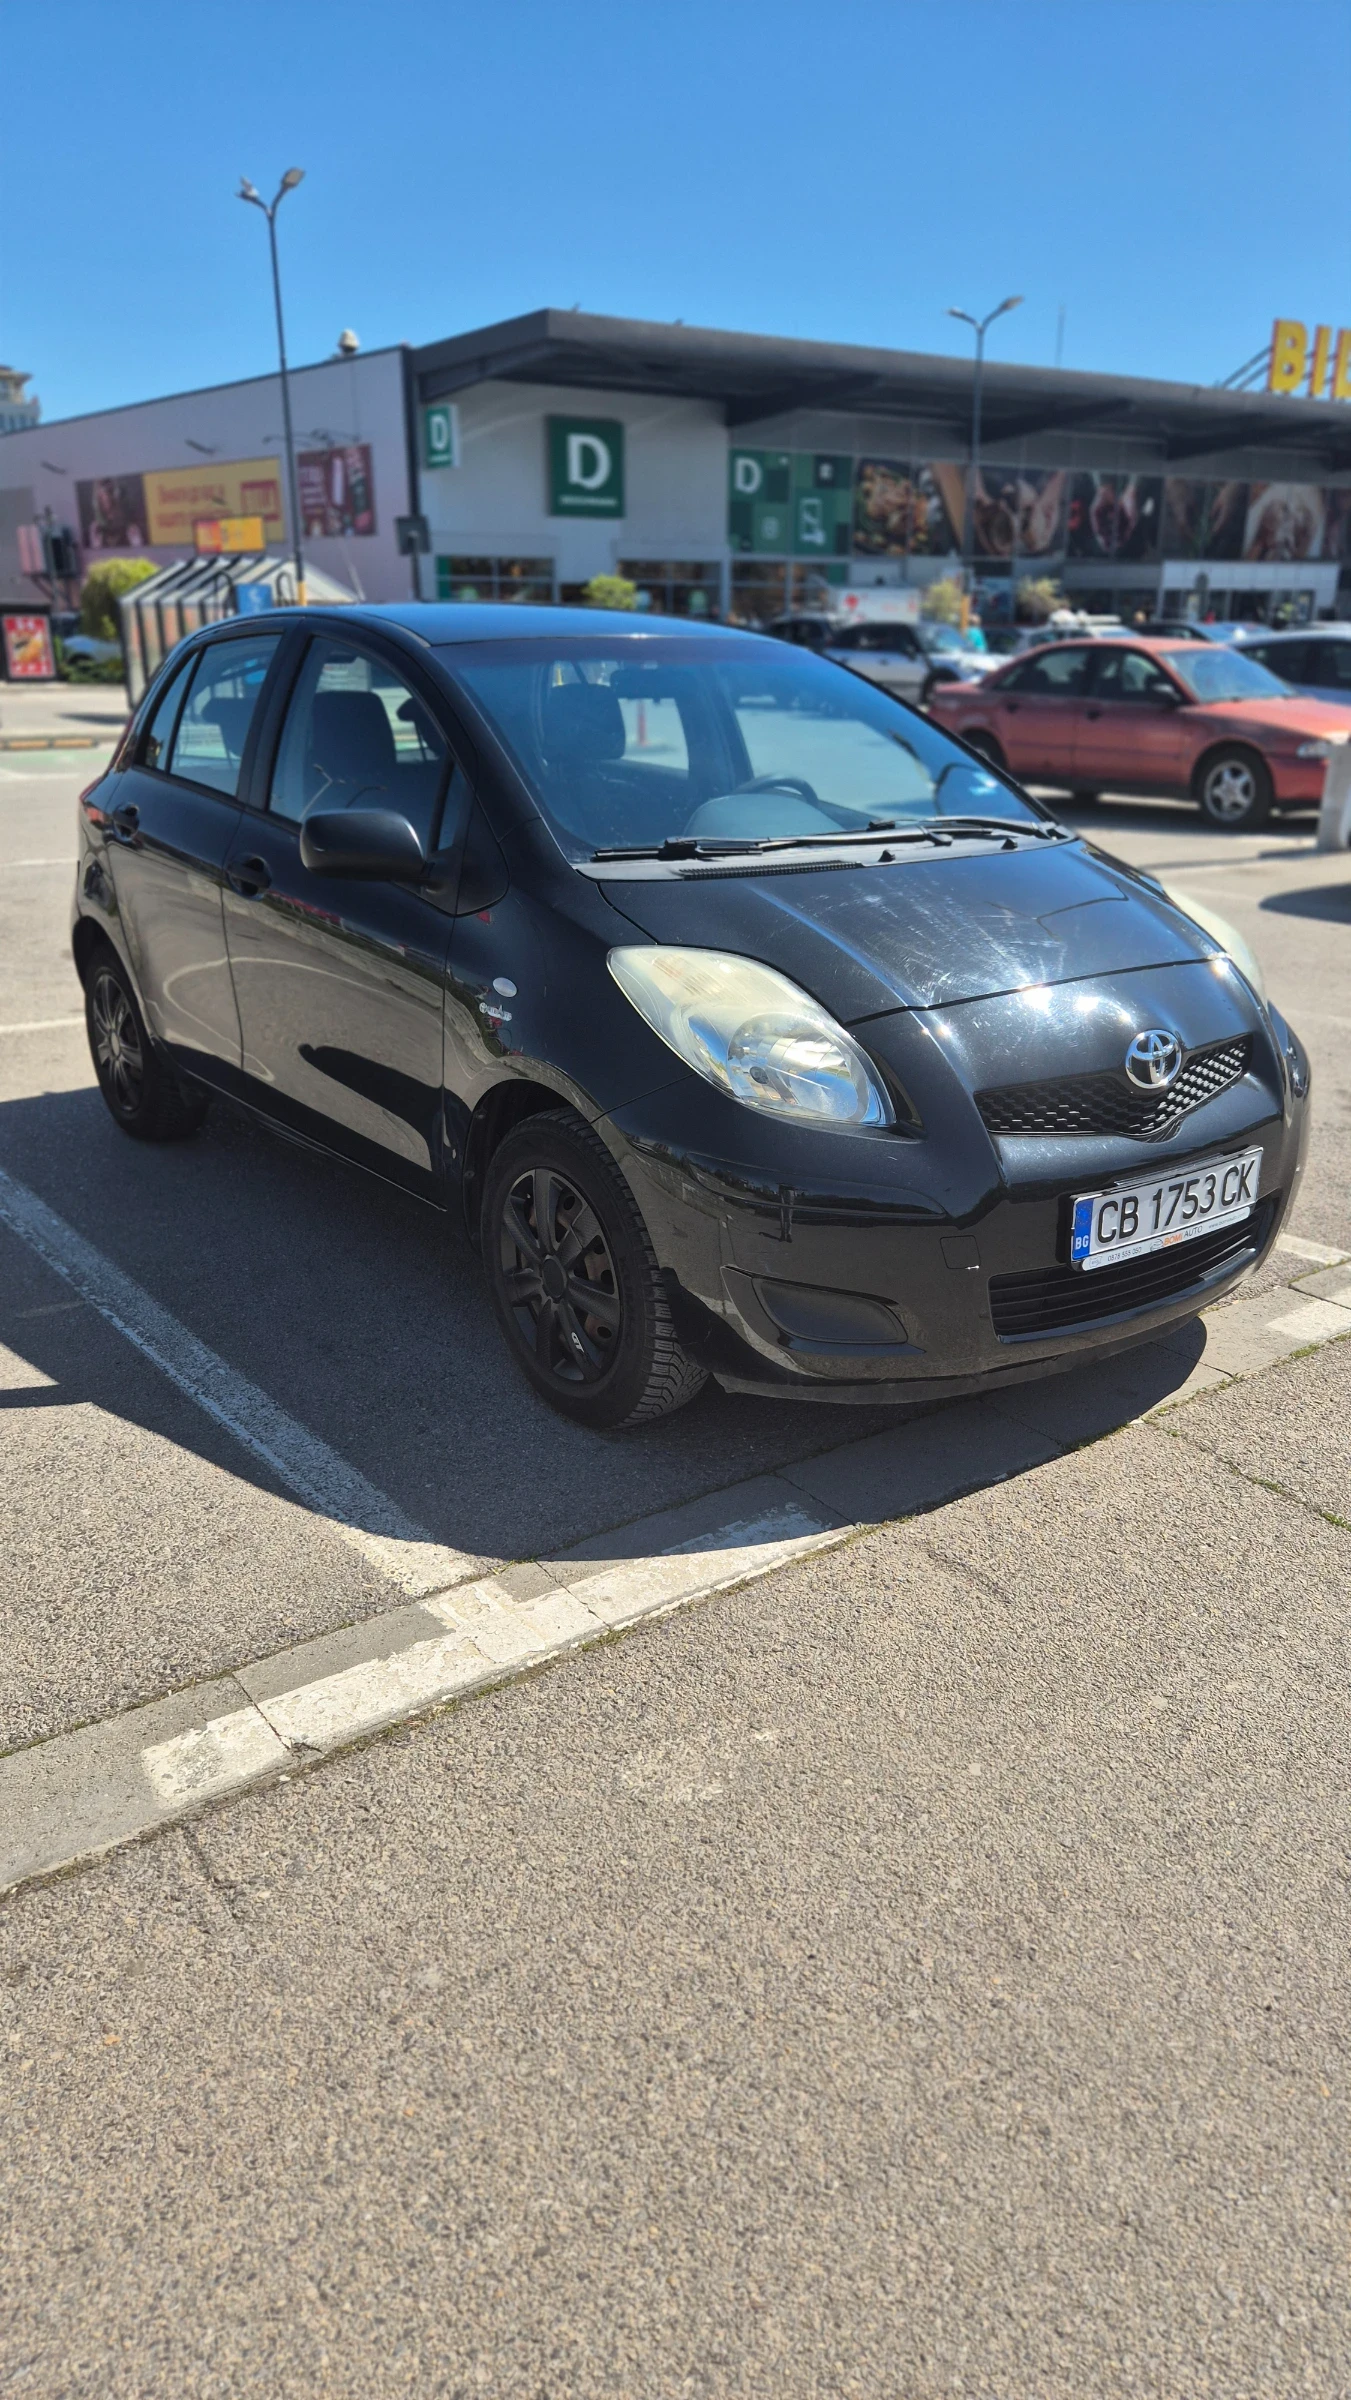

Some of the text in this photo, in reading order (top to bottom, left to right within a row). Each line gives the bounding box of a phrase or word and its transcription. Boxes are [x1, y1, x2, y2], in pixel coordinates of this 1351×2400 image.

[430, 414, 449, 450] D
[567, 433, 612, 490] D
[735, 457, 762, 494] D
[1097, 1160, 1256, 1243] CB 1753 CK
[1075, 1235, 1089, 1250] BG
[1163, 1233, 1183, 1246] BOMI
[1184, 1225, 1203, 1238] AUTO
